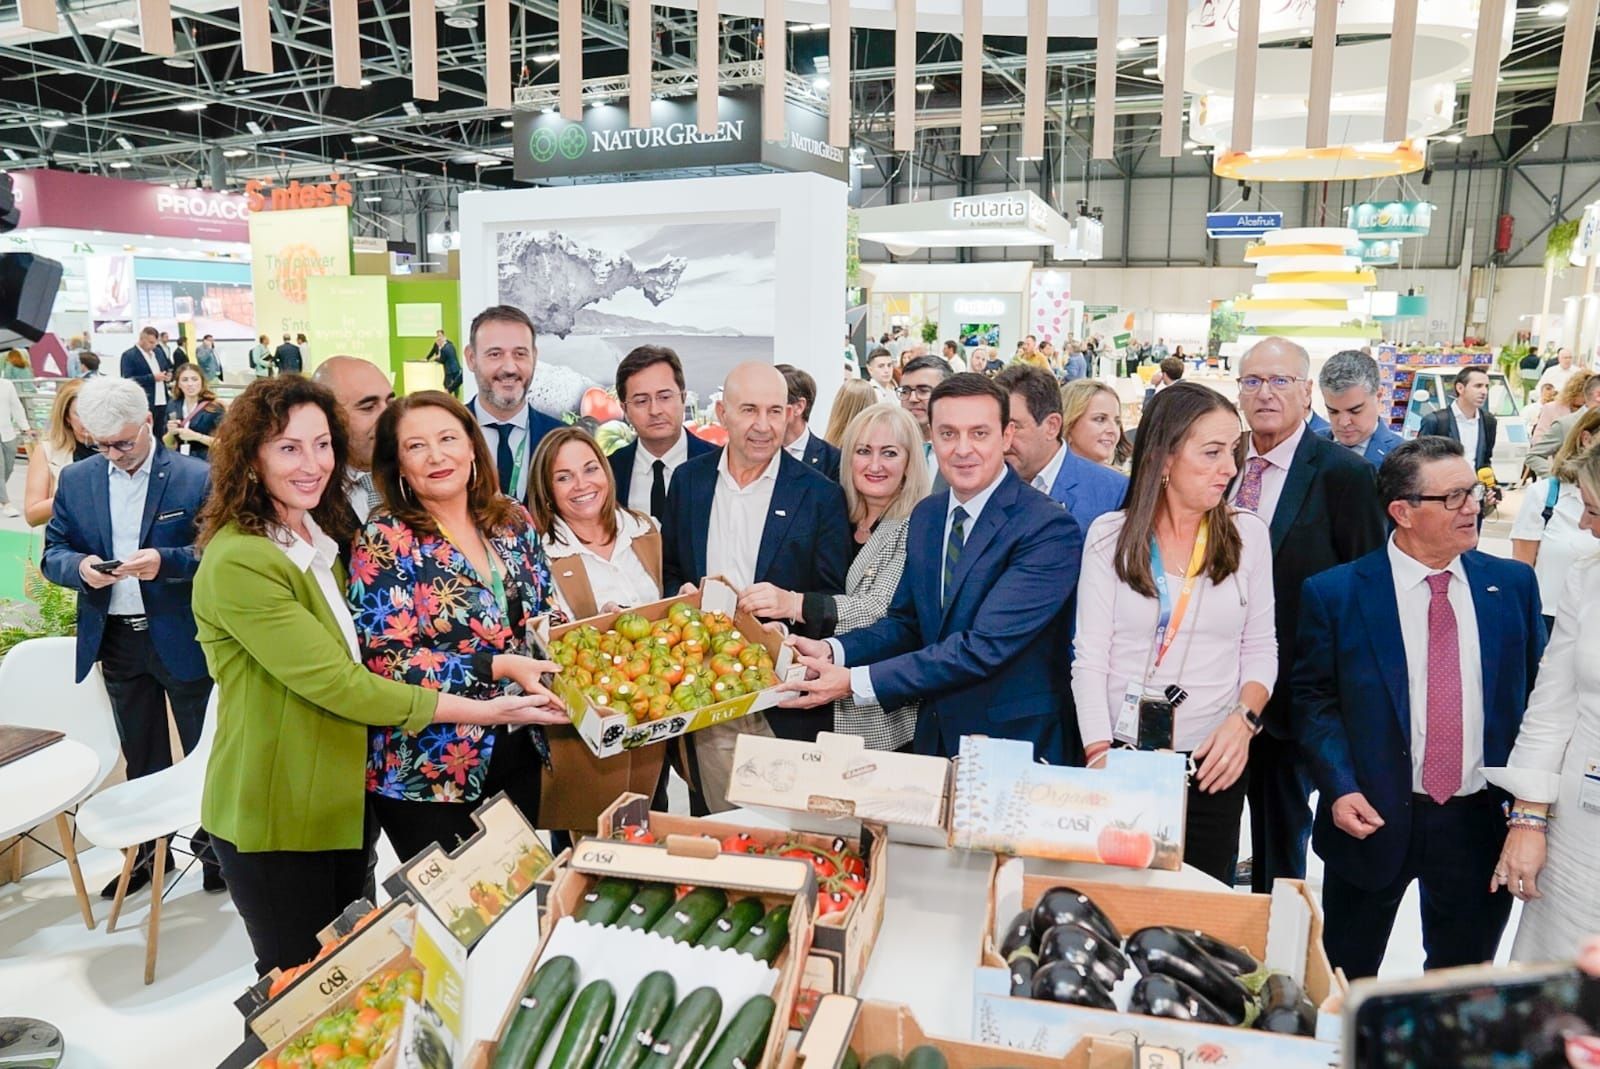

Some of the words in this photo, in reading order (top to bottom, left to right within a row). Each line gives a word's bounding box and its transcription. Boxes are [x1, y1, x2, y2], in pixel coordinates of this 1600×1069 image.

[592, 120, 744, 153] NATURGREEN
[790, 131, 844, 163] NATURGREEN
[319, 966, 349, 995] CASI
